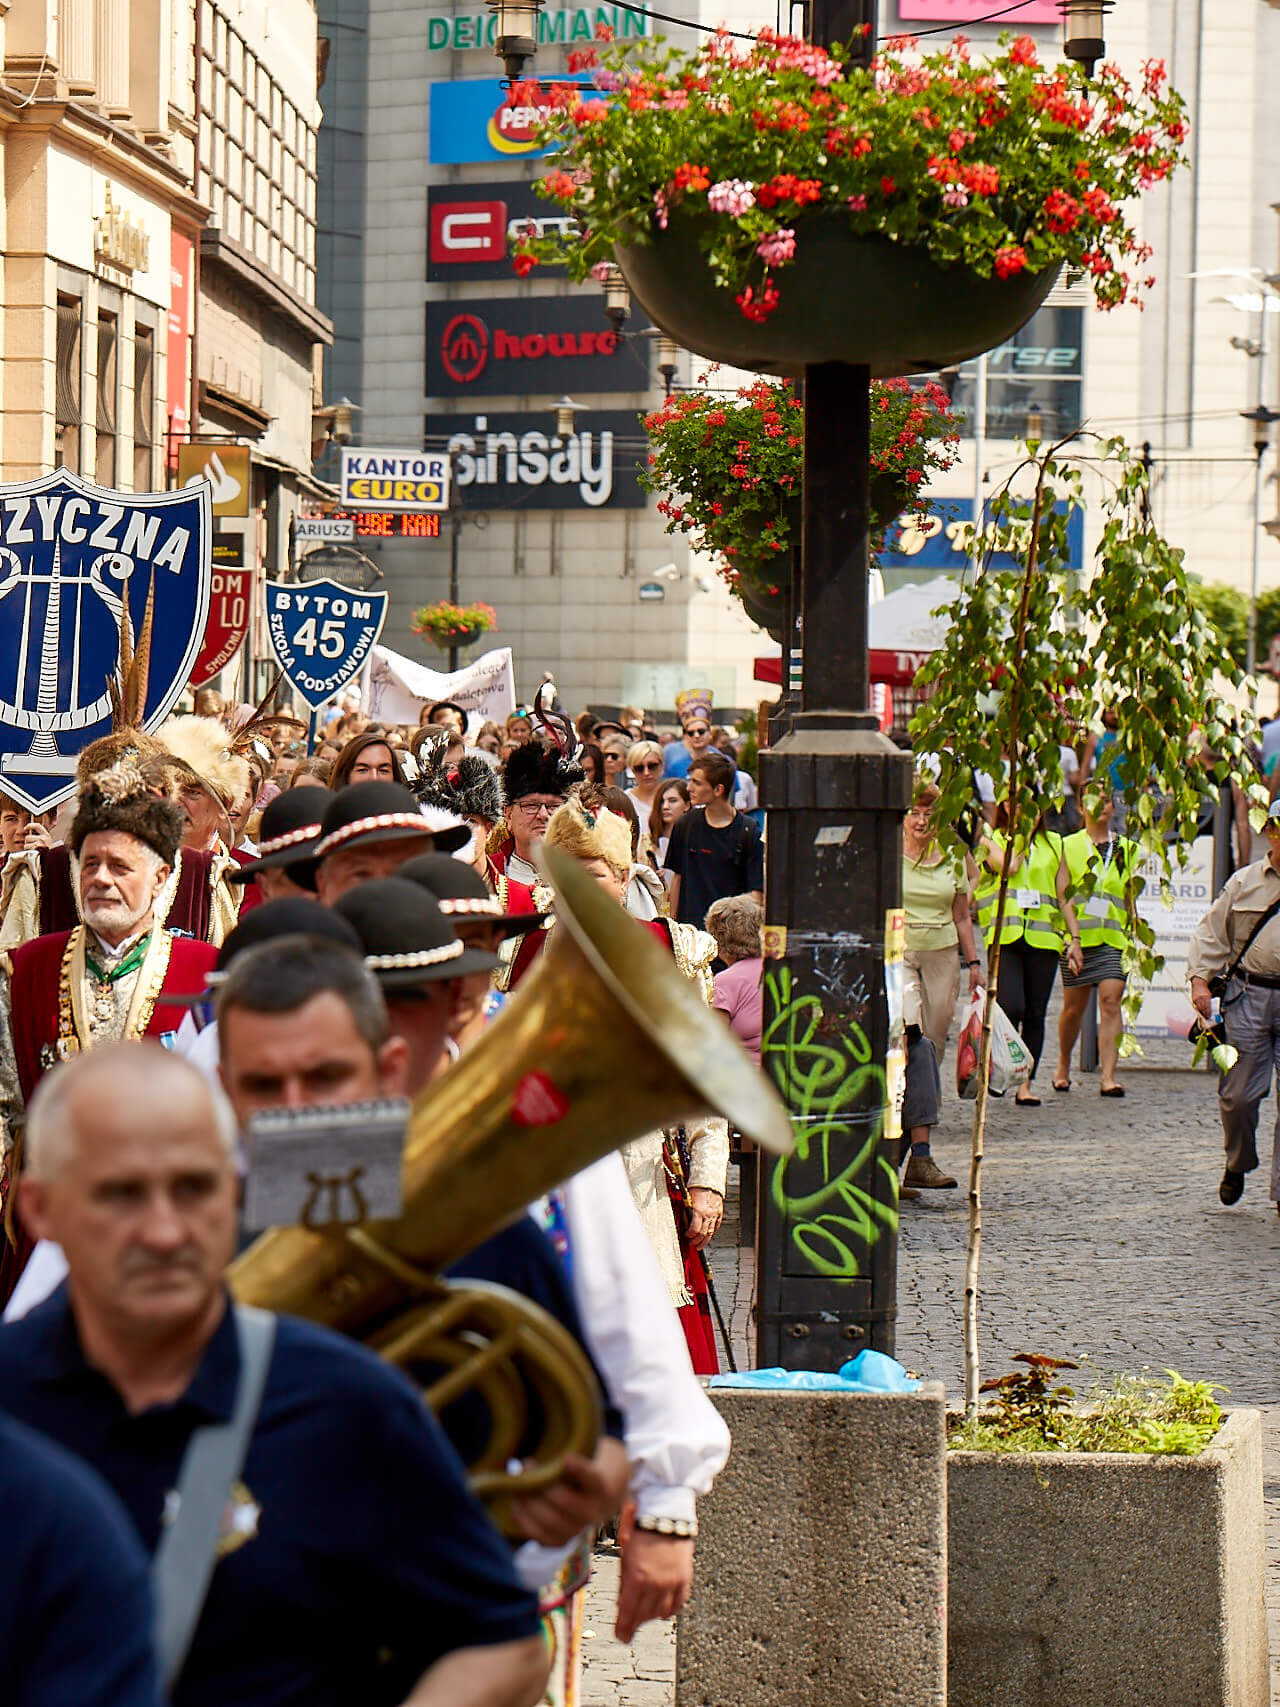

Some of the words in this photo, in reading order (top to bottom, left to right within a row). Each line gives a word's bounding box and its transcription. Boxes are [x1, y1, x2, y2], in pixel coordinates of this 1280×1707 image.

[347, 457, 443, 477] KANTOR
[448, 416, 613, 506] sinsay
[275, 593, 371, 619] BYTOM
[271, 614, 296, 669] SZKOŁA
[295, 626, 376, 692] PODSTAWOWA
[292, 617, 346, 658] 45
